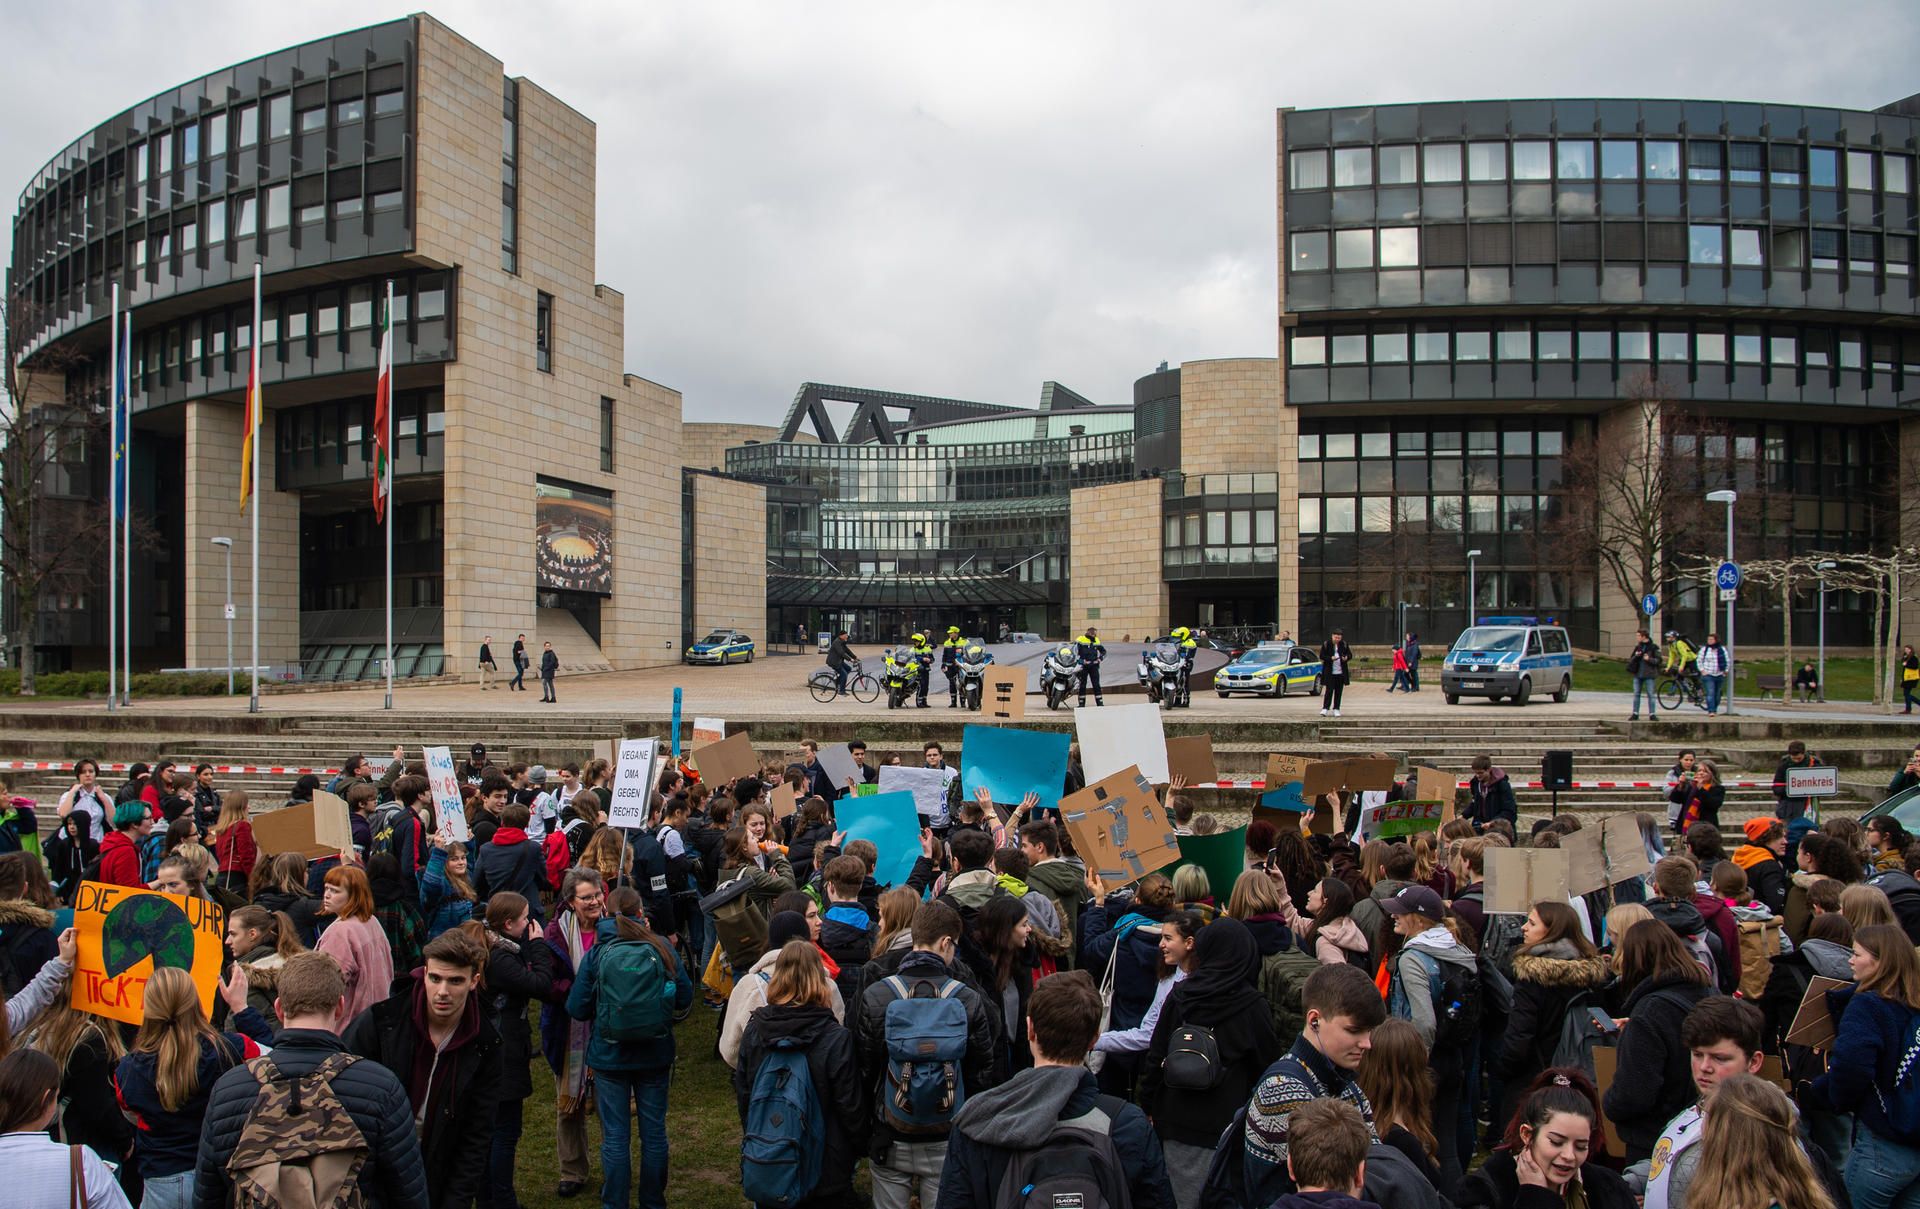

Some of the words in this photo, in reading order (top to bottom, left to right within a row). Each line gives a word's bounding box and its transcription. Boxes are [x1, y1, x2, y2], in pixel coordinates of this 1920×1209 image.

[621, 750, 649, 760] VEGANE
[1277, 755, 1297, 765] LIKE
[624, 768, 639, 779] OMA
[1279, 764, 1297, 774] SEA
[444, 776, 458, 795] es
[1791, 776, 1834, 788] Bannkreis
[617, 787, 641, 798] GEGEN
[441, 796, 462, 818] spät
[612, 806, 639, 817] RECHTS
[76, 884, 119, 915] DIE
[184, 895, 222, 939] UHR
